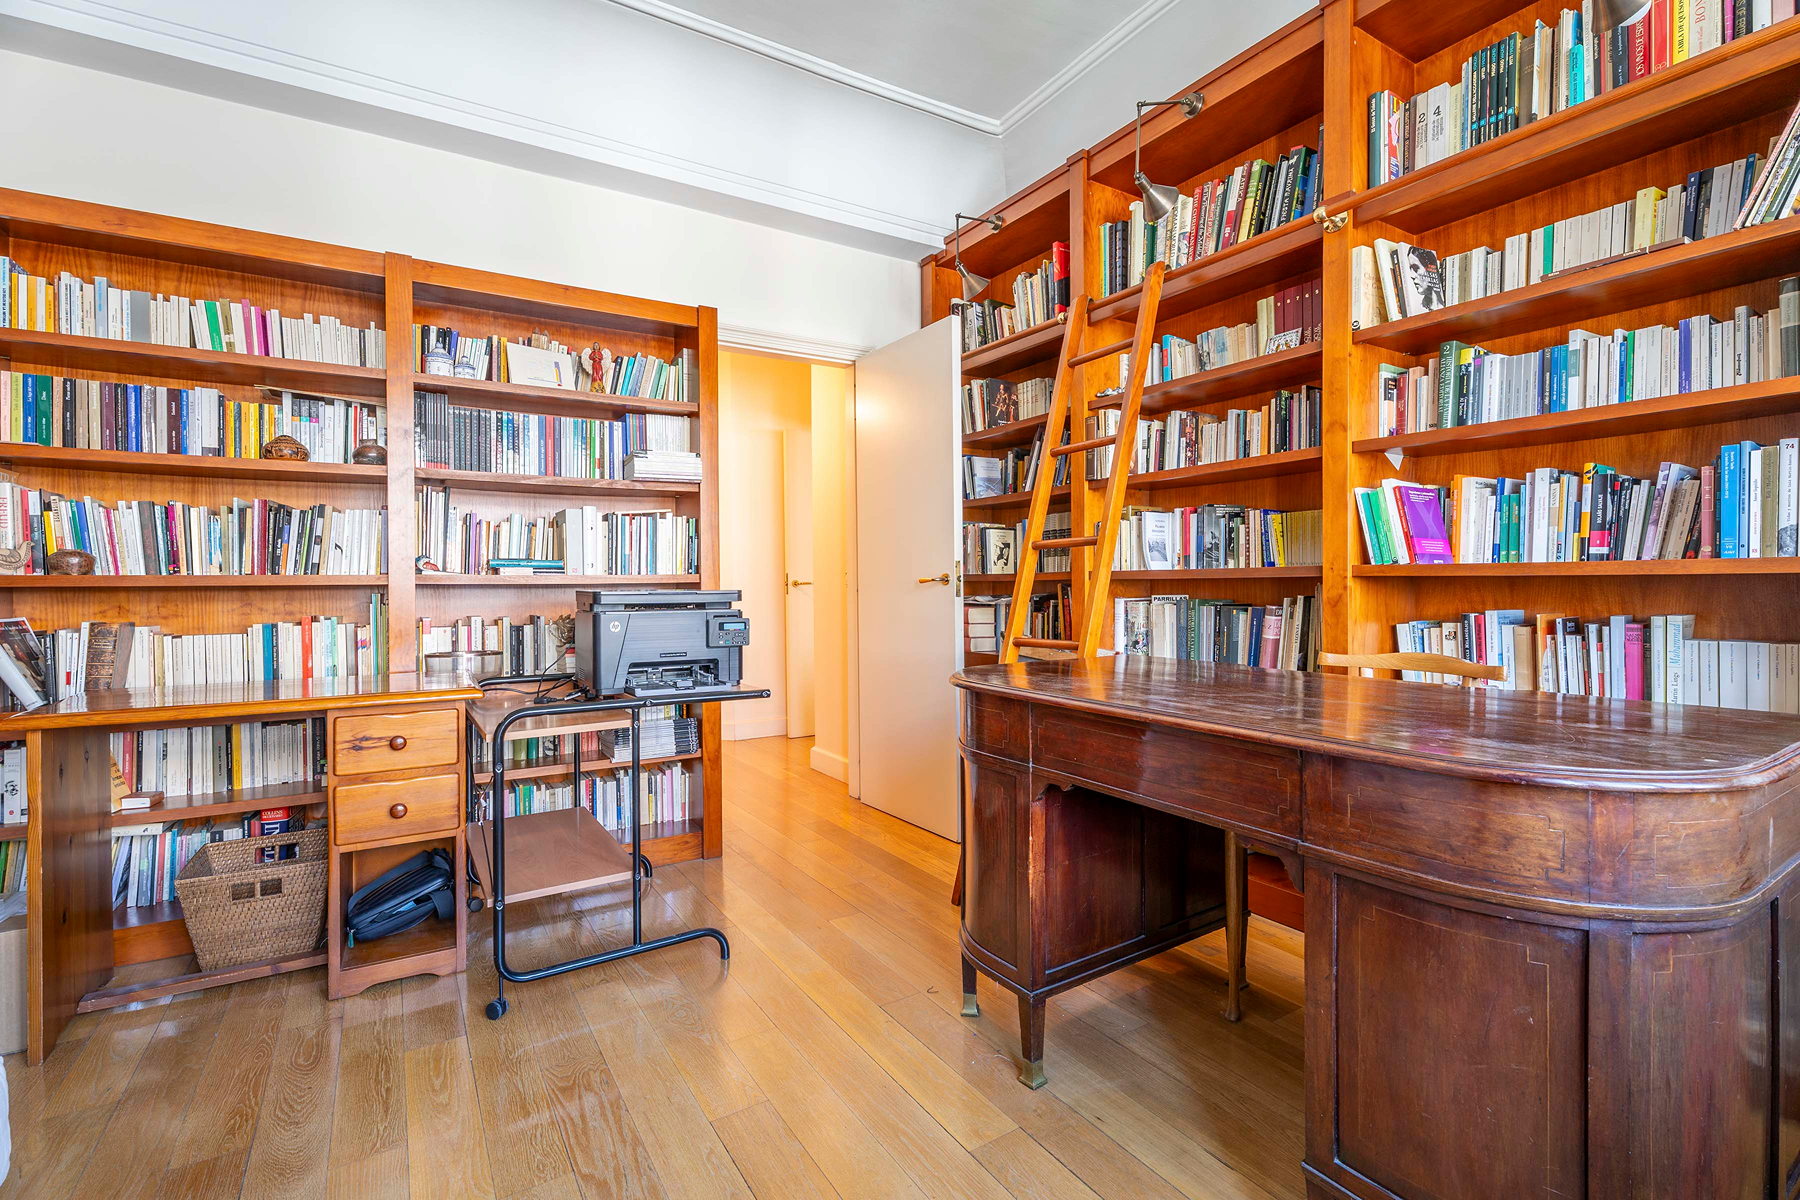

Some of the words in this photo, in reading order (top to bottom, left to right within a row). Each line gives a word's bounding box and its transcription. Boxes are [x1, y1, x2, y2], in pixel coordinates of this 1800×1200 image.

[1433, 105, 1441, 117] 4
[1418, 113, 1425, 124] 2
[1190, 208, 1198, 246] CHRISTIAN
[1444, 345, 1450, 354] 2
[0, 497, 8, 529] FREUD
[1669, 623, 1680, 665] Muhammad
[1671, 672, 1680, 686] Lings
